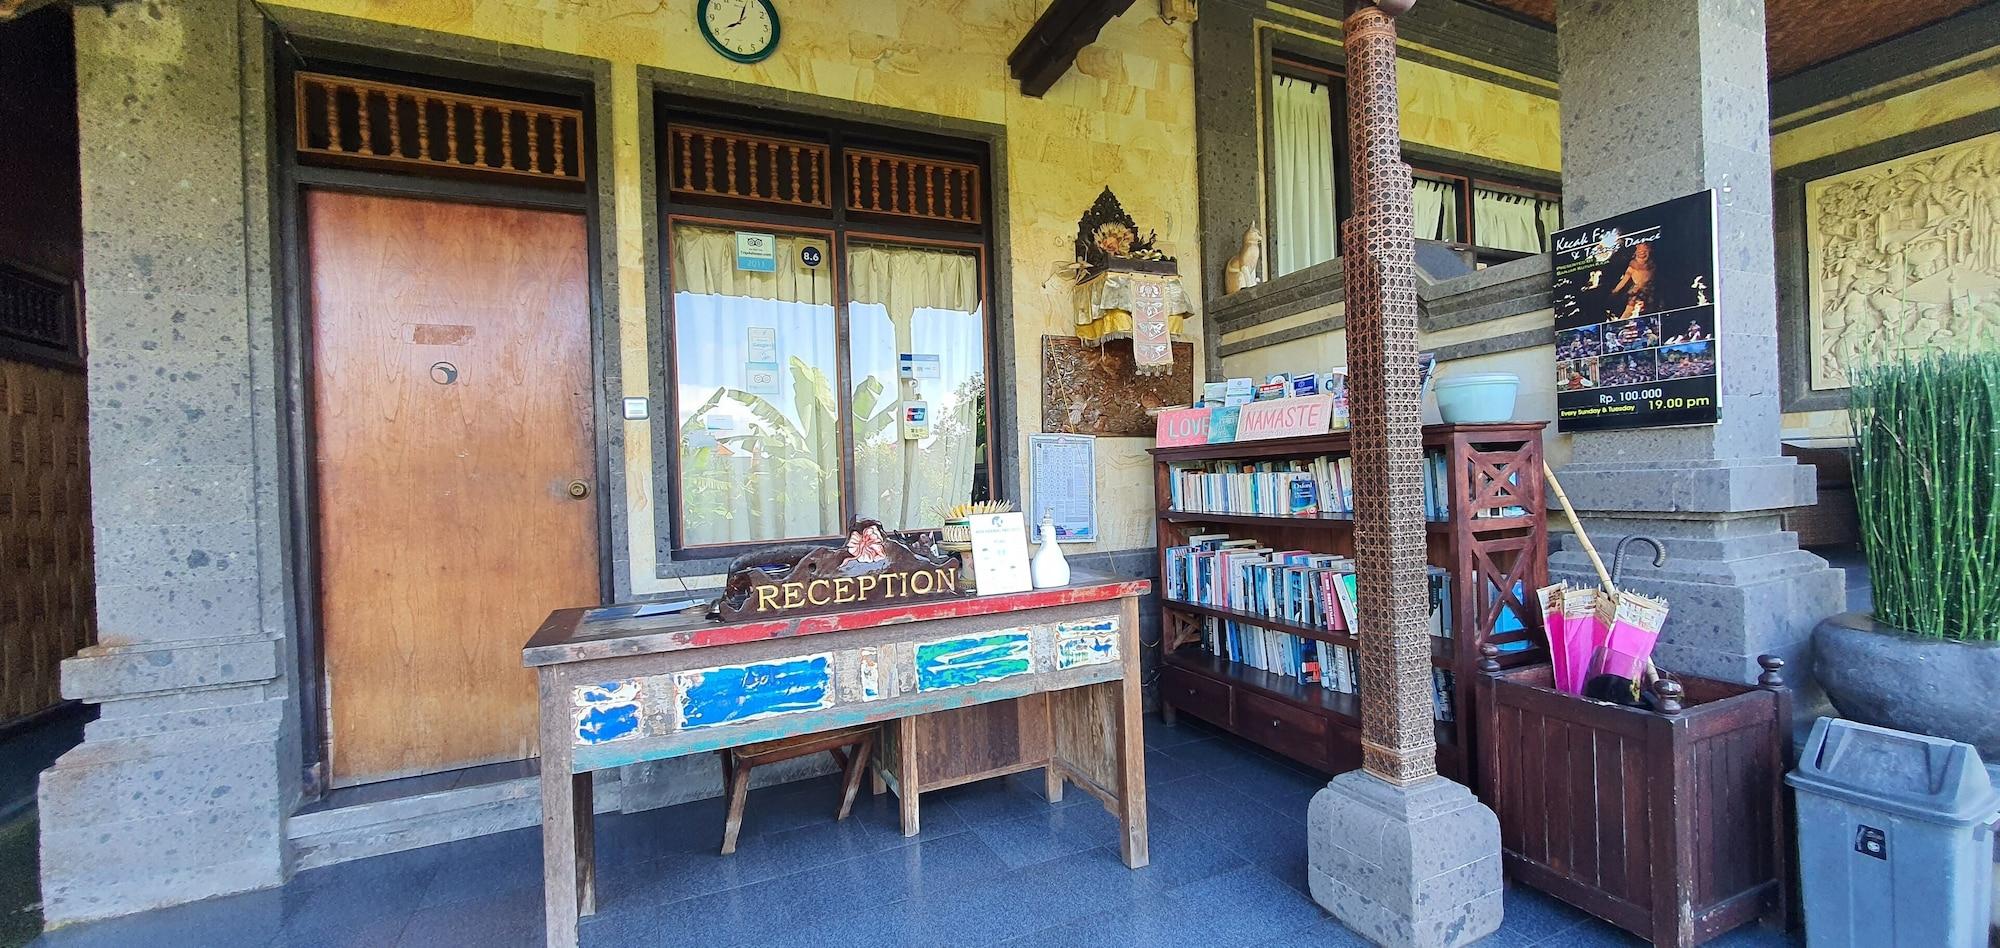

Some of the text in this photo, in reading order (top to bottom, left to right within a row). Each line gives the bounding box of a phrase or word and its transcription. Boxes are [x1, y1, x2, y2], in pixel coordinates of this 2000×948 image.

[713, 2, 722, 11] 10
[709, 13, 715, 22] 9
[759, 12, 767, 20] 2
[714, 28, 720, 36] 8
[763, 25, 769, 33] 3
[724, 38, 730, 46] 7
[759, 36, 764, 44] 4
[737, 44, 743, 52] 6
[750, 44, 756, 52] 5
[1556, 232, 1588, 251] Kecak
[1624, 232, 1661, 248] Dance
[803, 251, 819, 262] 8.6
[1599, 388, 1662, 404] Rp. 100.000
[1649, 397, 1710, 410] 19.00 pm
[1560, 408, 1577, 418] Every
[1578, 405, 1601, 416] Sunday
[1608, 404, 1636, 413] Tuesday
[1244, 403, 1321, 432] NAMASTE
[1168, 417, 1209, 440] LOVE
[756, 568, 958, 612] RECEPTION
